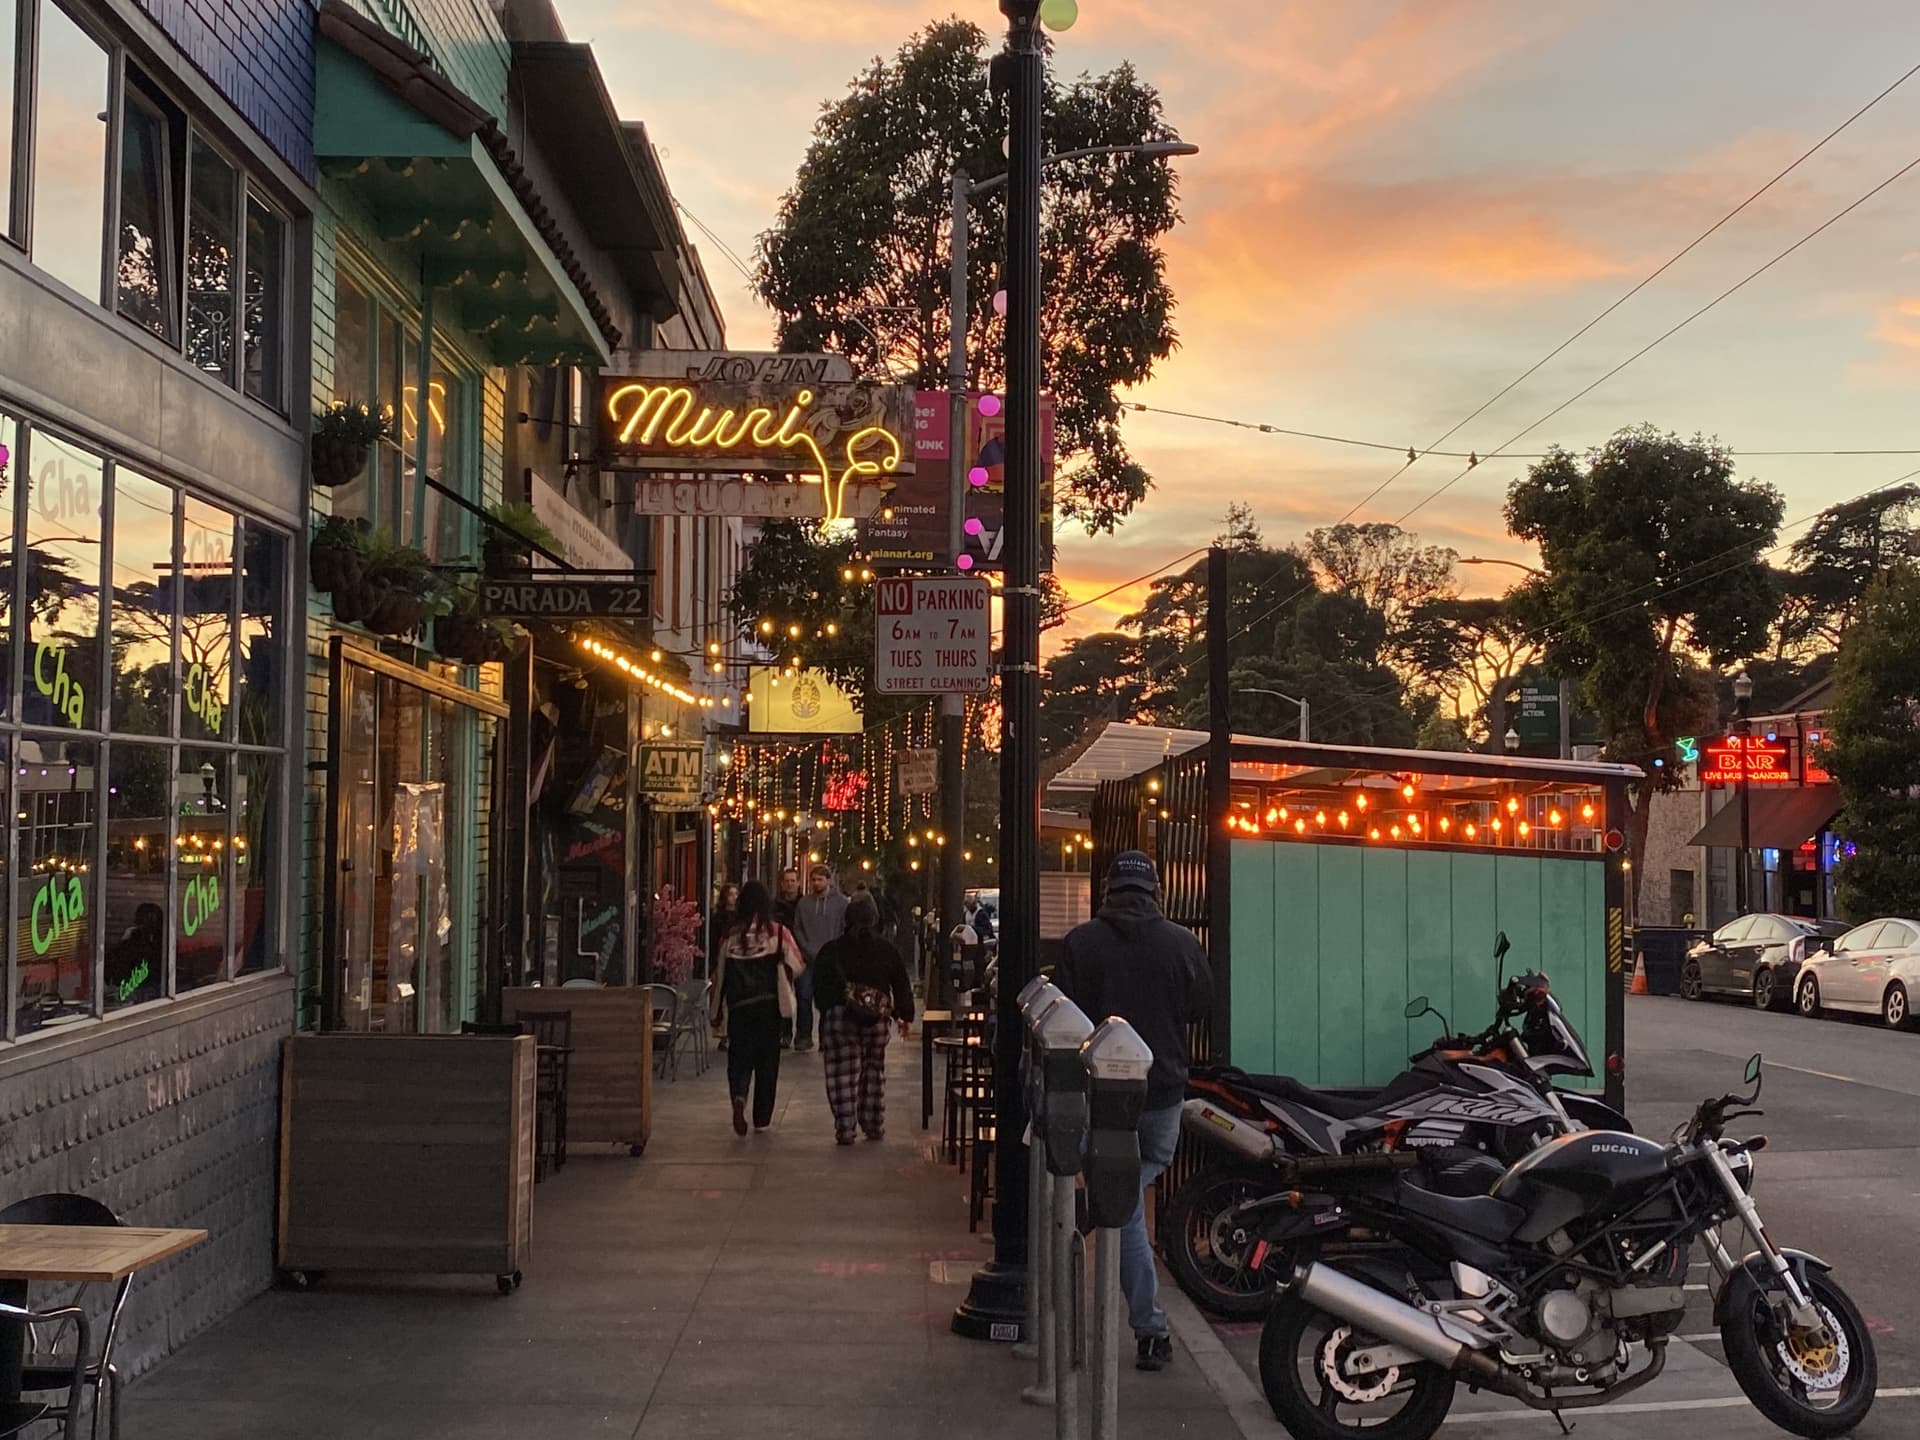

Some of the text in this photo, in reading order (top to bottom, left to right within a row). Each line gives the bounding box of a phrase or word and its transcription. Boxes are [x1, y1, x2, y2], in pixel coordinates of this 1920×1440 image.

[687, 357, 829, 382] JOHN
[38, 459, 90, 522] Cha
[893, 504, 937, 515] nimated
[868, 528, 908, 539] Fantasy
[485, 586, 643, 614] PARADA 22
[881, 582, 985, 611] NO PARKING
[929, 631, 939, 640] TO
[890, 649, 977, 668] TUES THURS
[33, 637, 221, 735] Cha Cha
[886, 677, 981, 690] STREET CLEANING
[1727, 737, 1766, 749] MLK
[644, 751, 700, 775] ATM
[1719, 754, 1775, 770] BAR
[31, 874, 220, 955] Cha Cha
[1591, 1144, 1640, 1156] DUCATI
